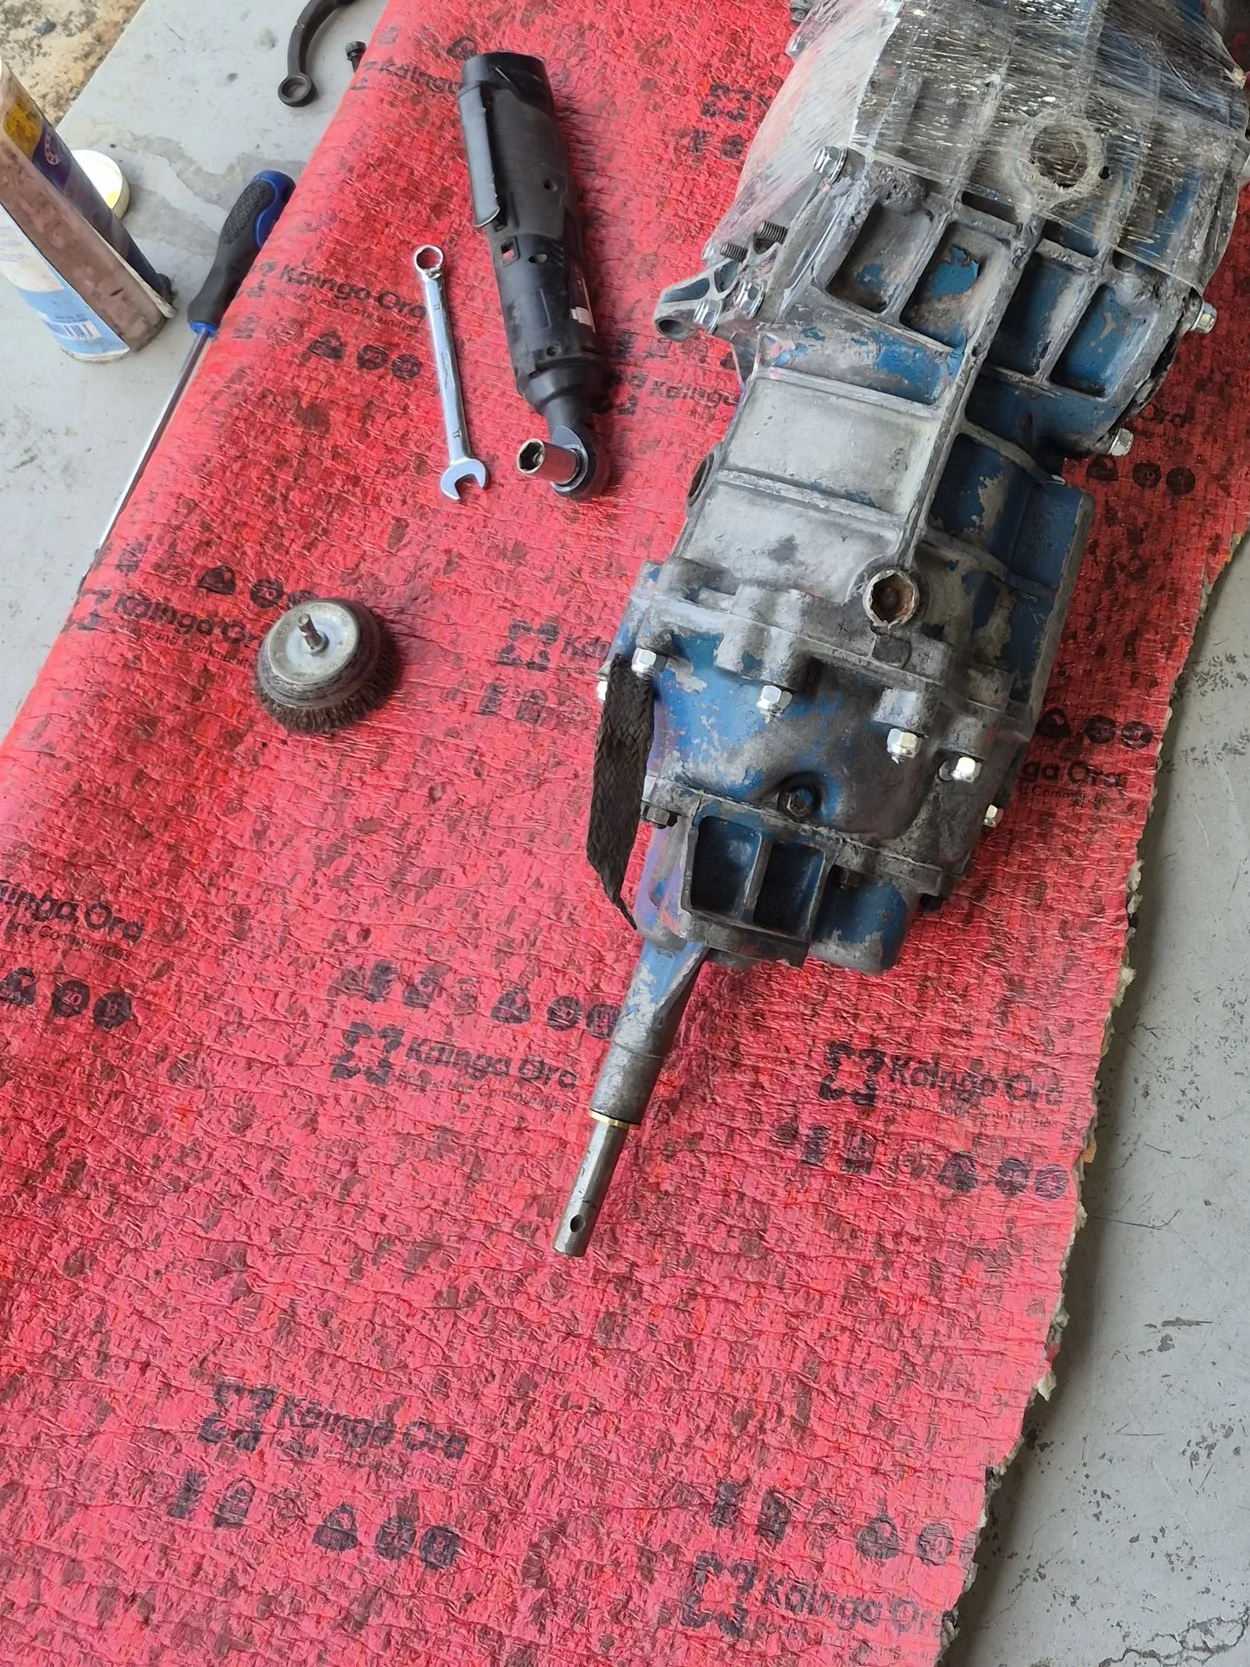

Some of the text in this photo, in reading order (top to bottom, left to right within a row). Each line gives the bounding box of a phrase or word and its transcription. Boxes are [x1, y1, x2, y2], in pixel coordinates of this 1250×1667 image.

[375, 289, 427, 320] Ora
[1067, 761, 1128, 788] Ora
[84, 902, 144, 942] Ora
[518, 1057, 578, 1090] Ora
